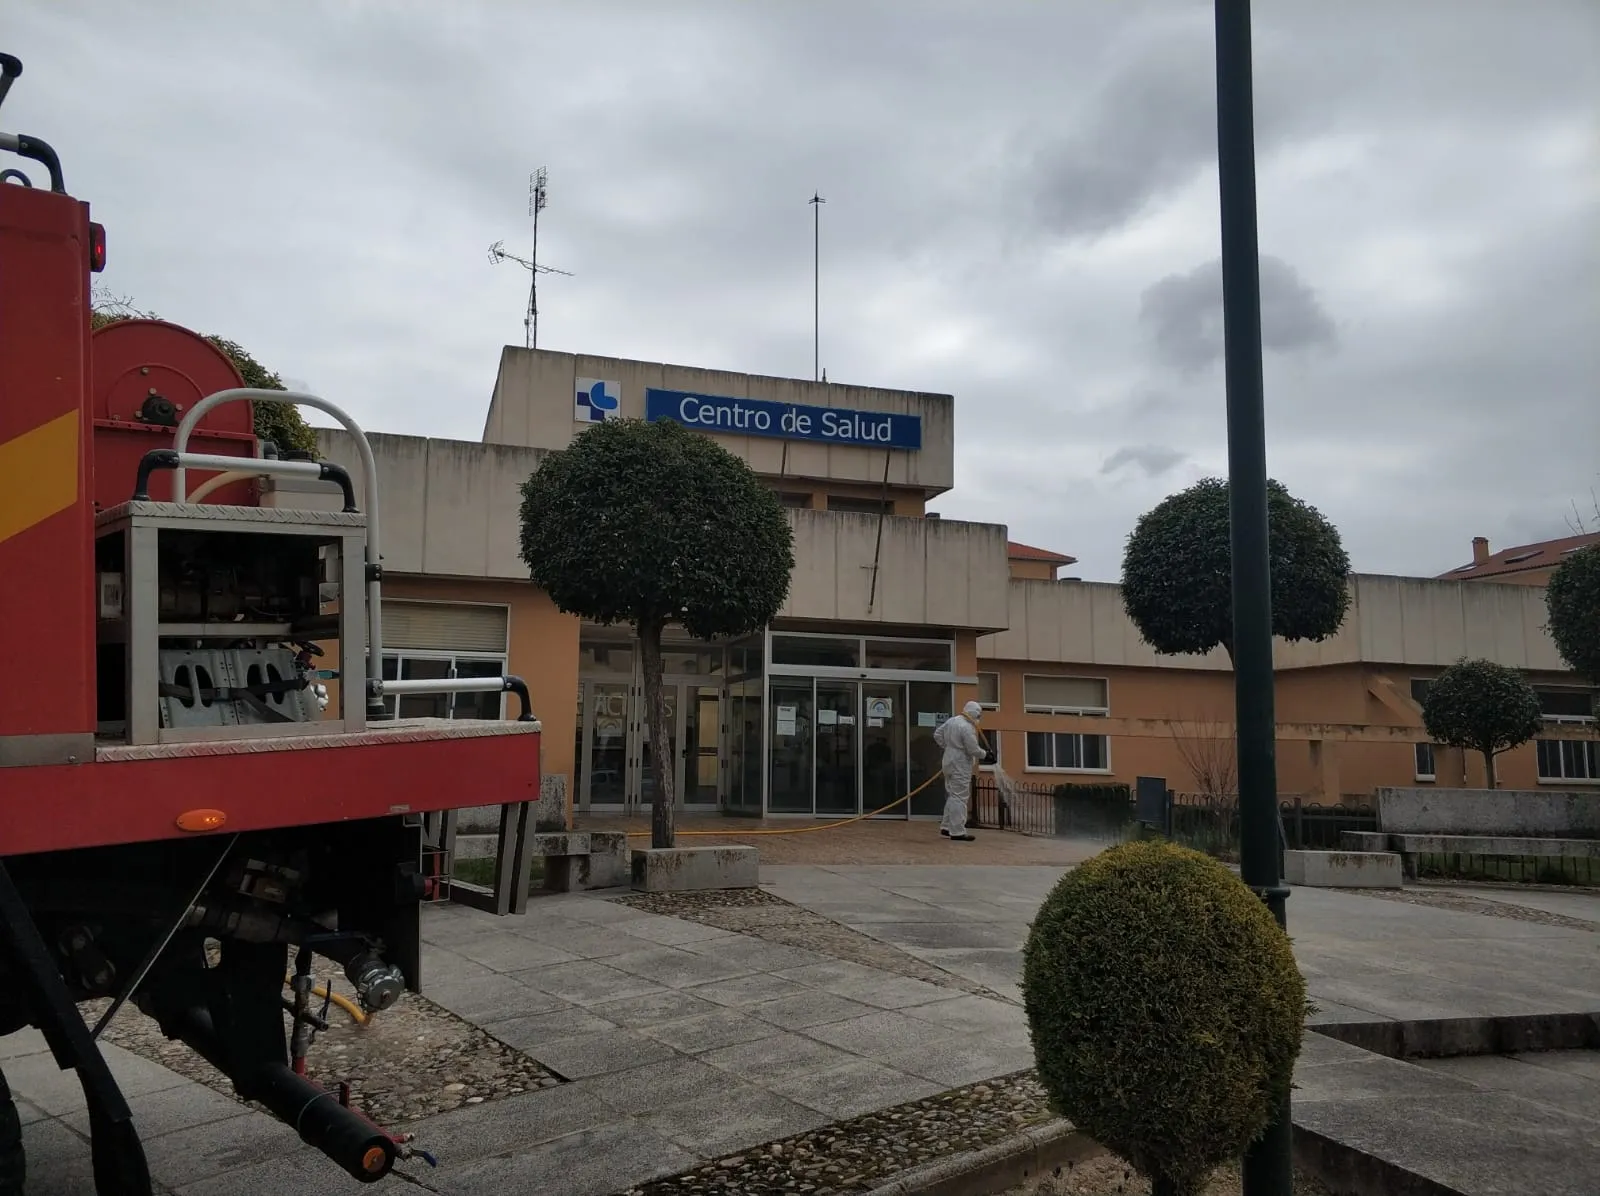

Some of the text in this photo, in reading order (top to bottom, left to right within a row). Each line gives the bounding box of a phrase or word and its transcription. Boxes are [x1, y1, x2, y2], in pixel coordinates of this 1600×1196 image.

[679, 397, 892, 442] Centro de Salud
